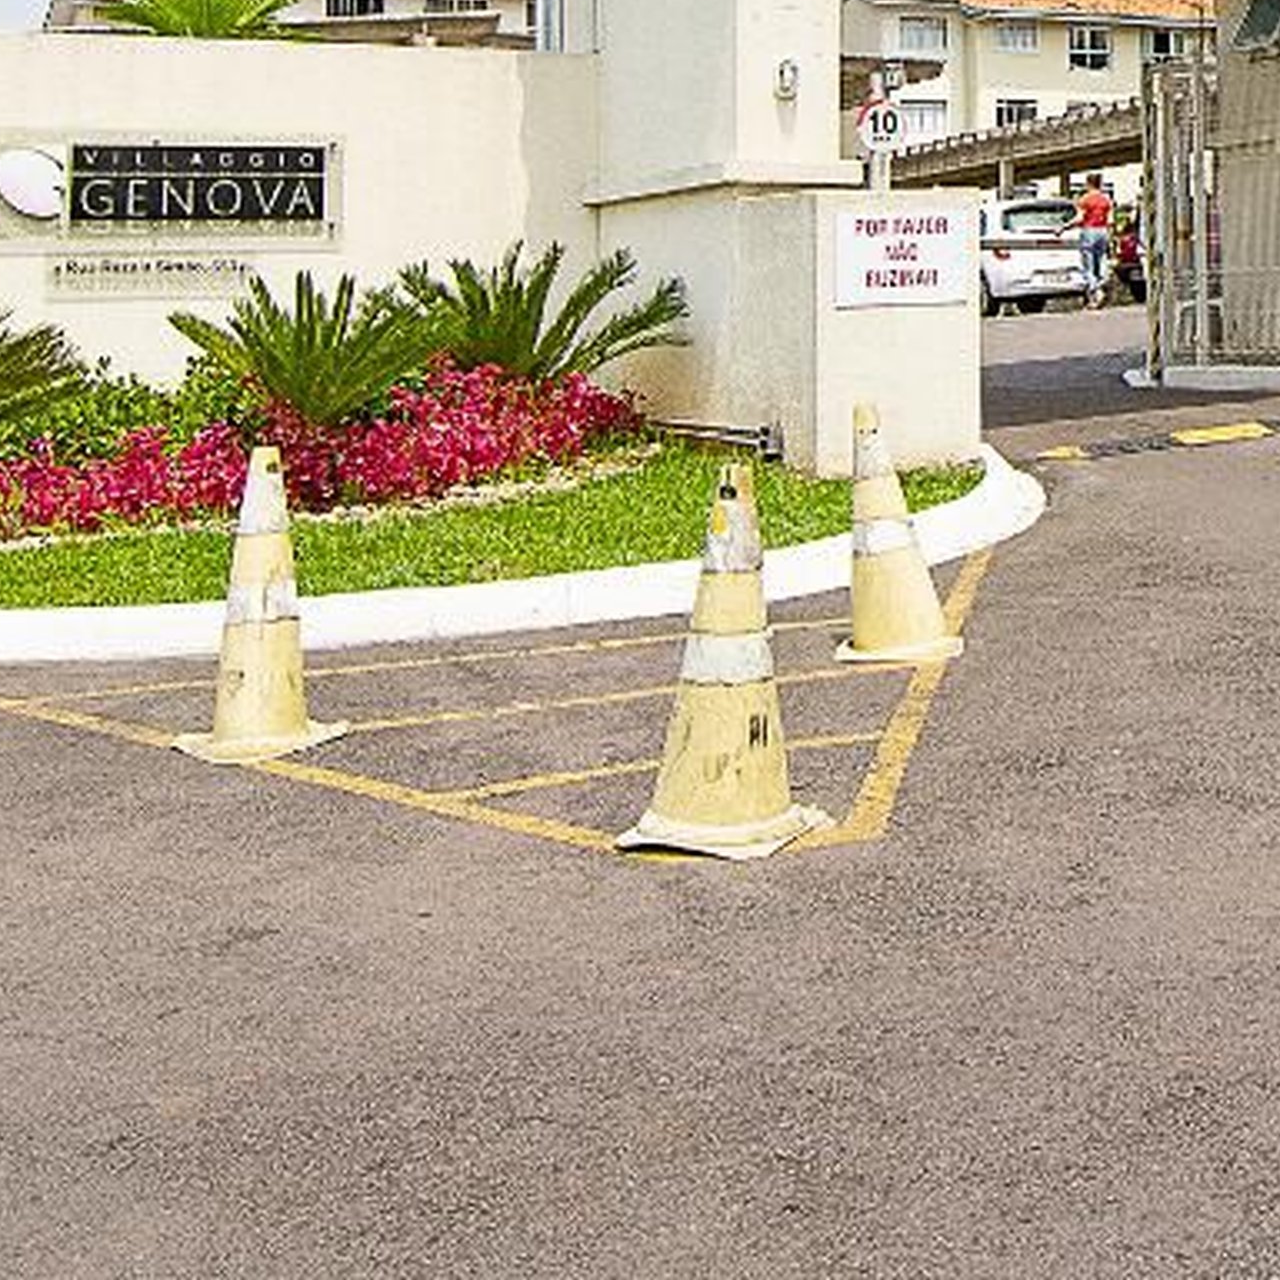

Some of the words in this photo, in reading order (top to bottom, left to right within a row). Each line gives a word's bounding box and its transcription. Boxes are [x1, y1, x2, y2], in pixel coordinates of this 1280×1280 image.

[869, 110, 897, 133] 10
[82, 150, 316, 168] VILLAGGIO
[80, 178, 316, 217] GENOVA
